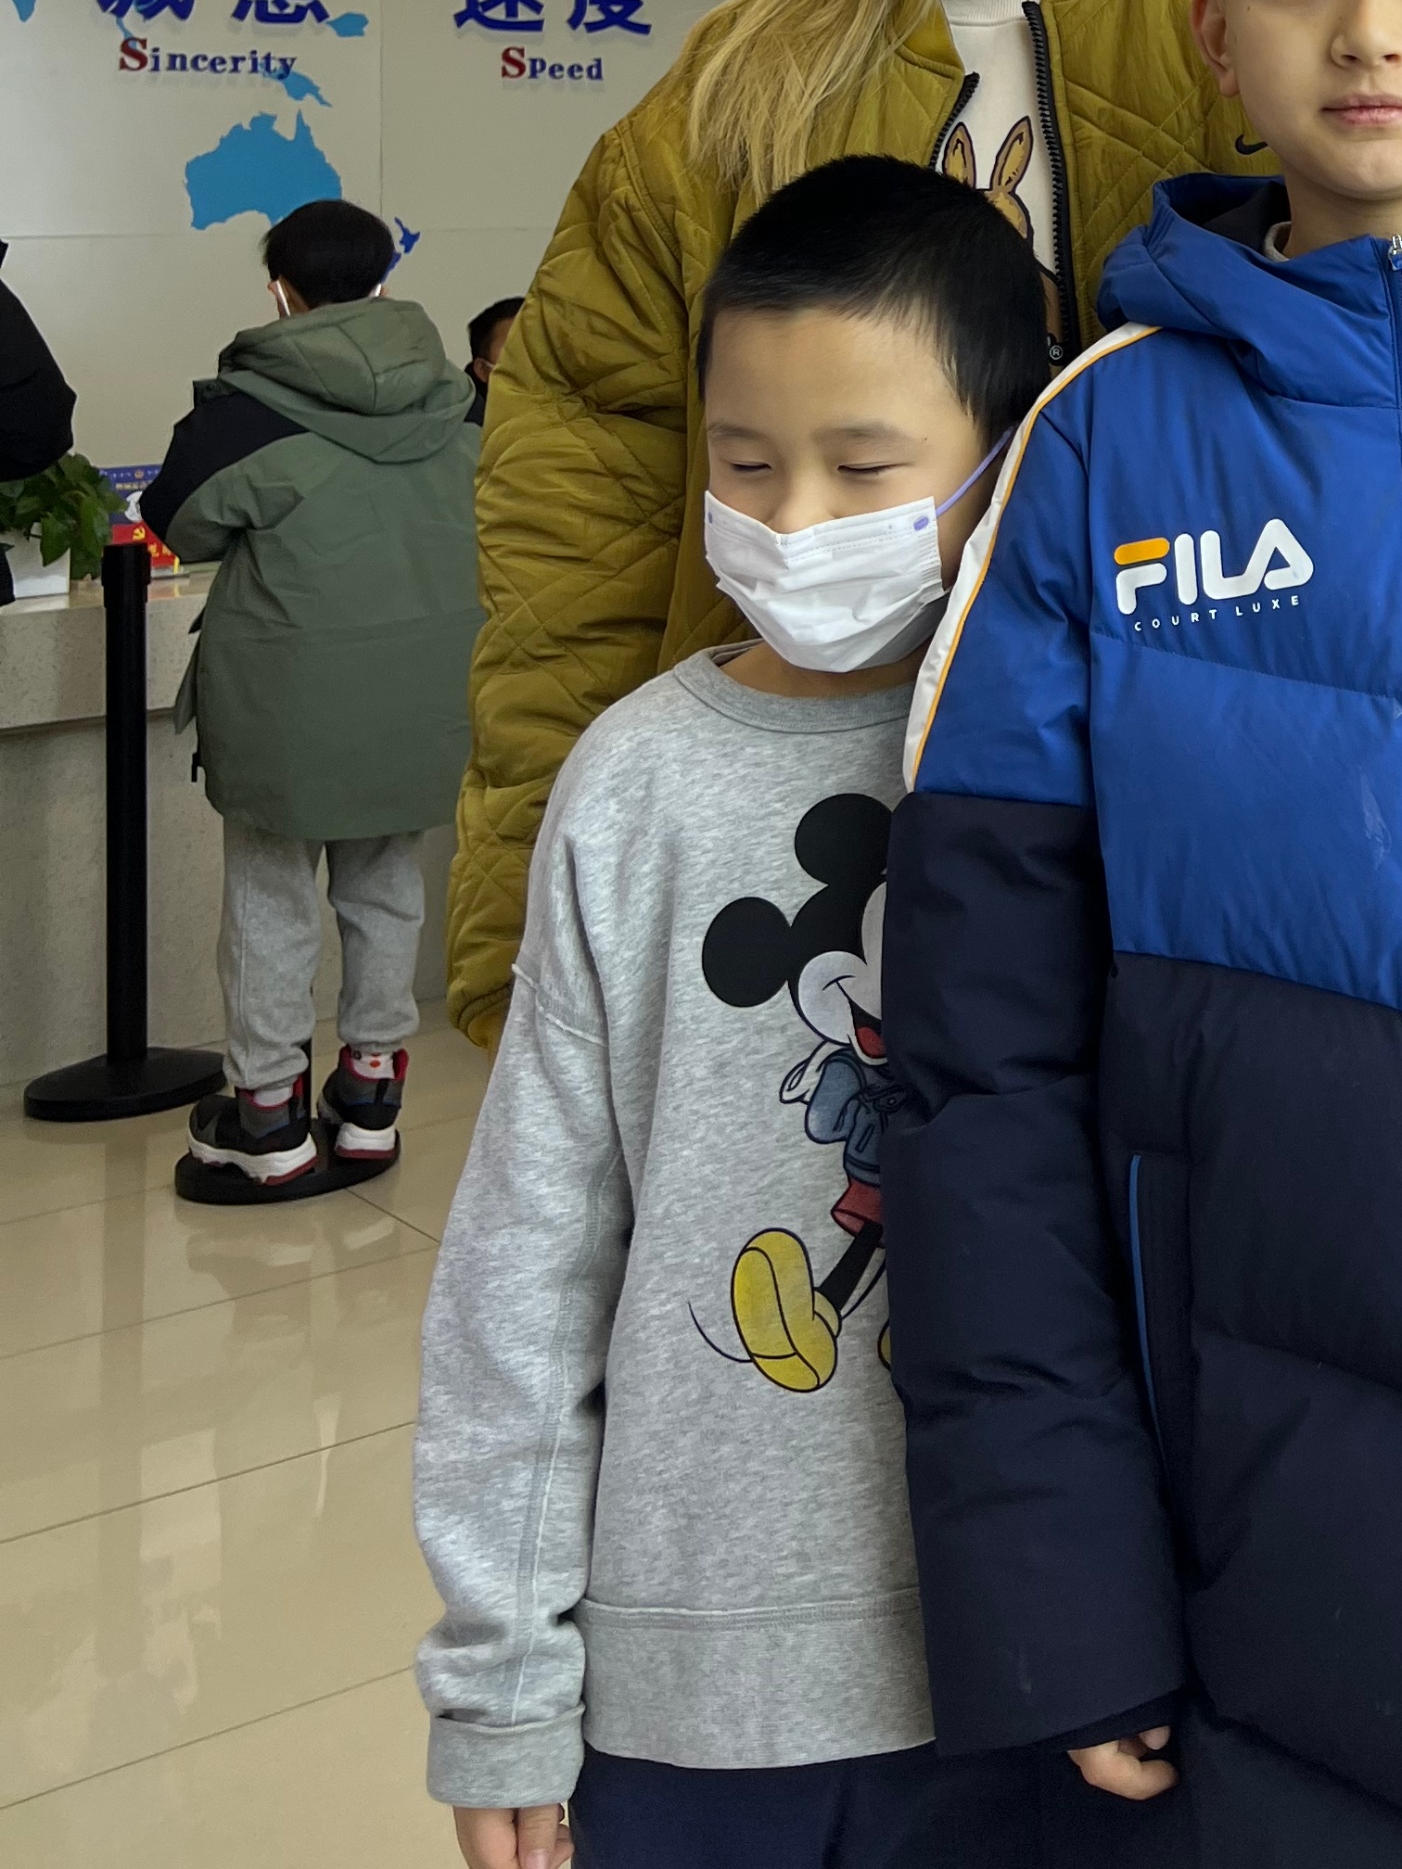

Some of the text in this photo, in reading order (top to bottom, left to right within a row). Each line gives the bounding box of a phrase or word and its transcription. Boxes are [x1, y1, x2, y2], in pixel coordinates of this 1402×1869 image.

[119, 37, 297, 80] Sincerity
[1114, 518, 1314, 615] FILA
[1134, 595, 1299, 632] COURT LUXE
